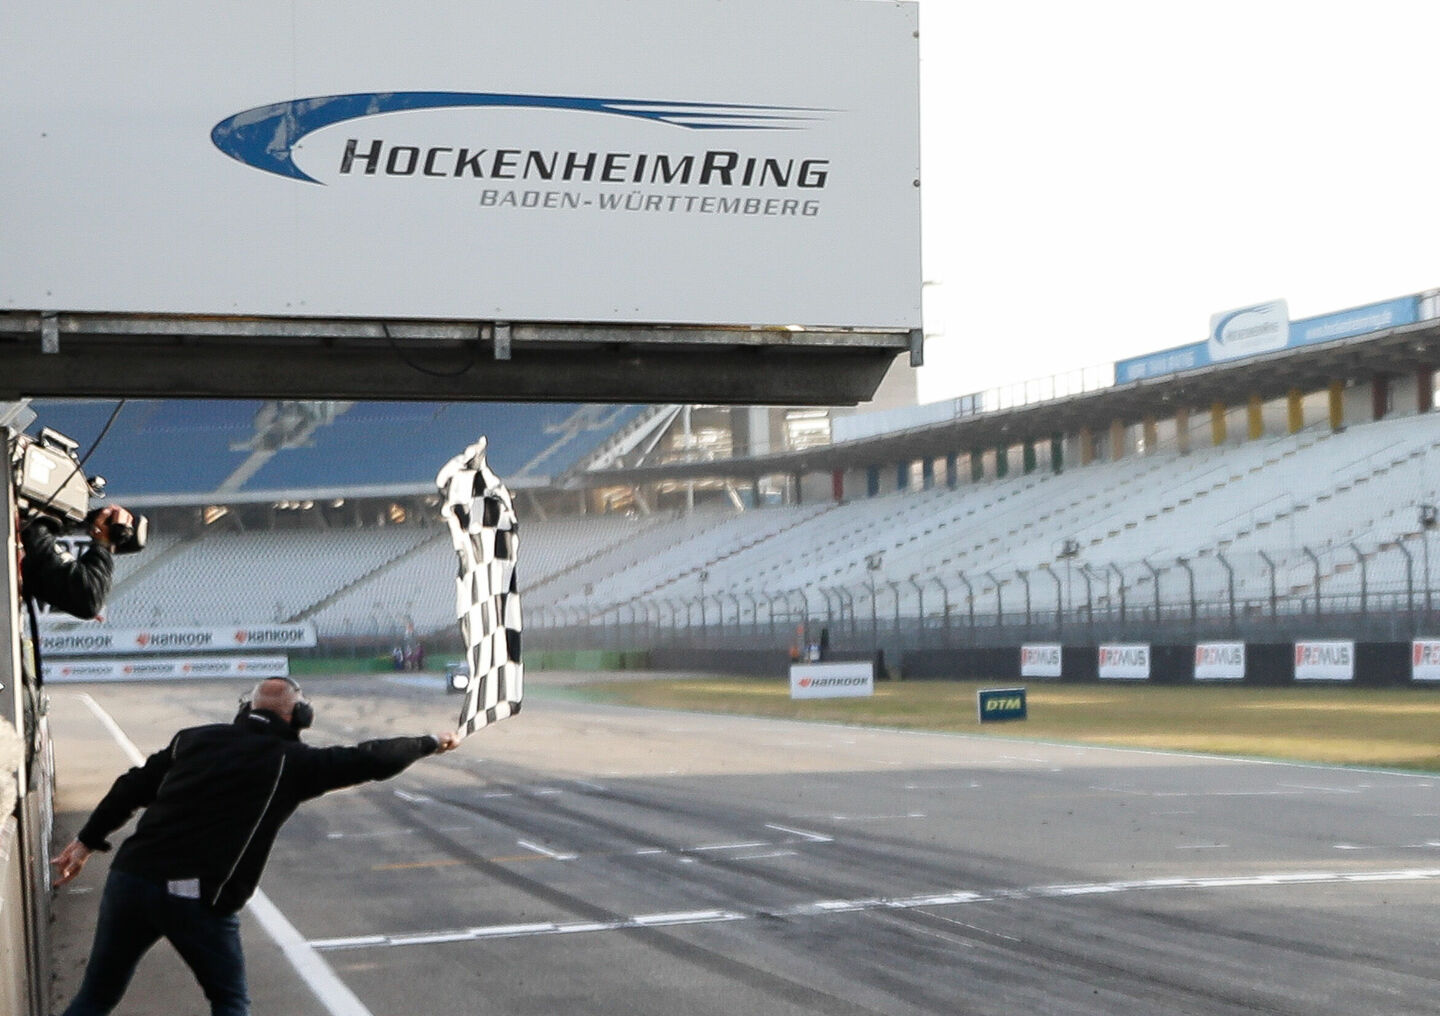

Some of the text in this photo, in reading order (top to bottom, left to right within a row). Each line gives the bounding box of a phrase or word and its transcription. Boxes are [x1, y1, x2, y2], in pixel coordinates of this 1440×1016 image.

[479, 188, 820, 217] BADEN-WÜRTTEMBERG
[1304, 646, 1349, 667] REMUS
[985, 698, 1021, 711] DTM
